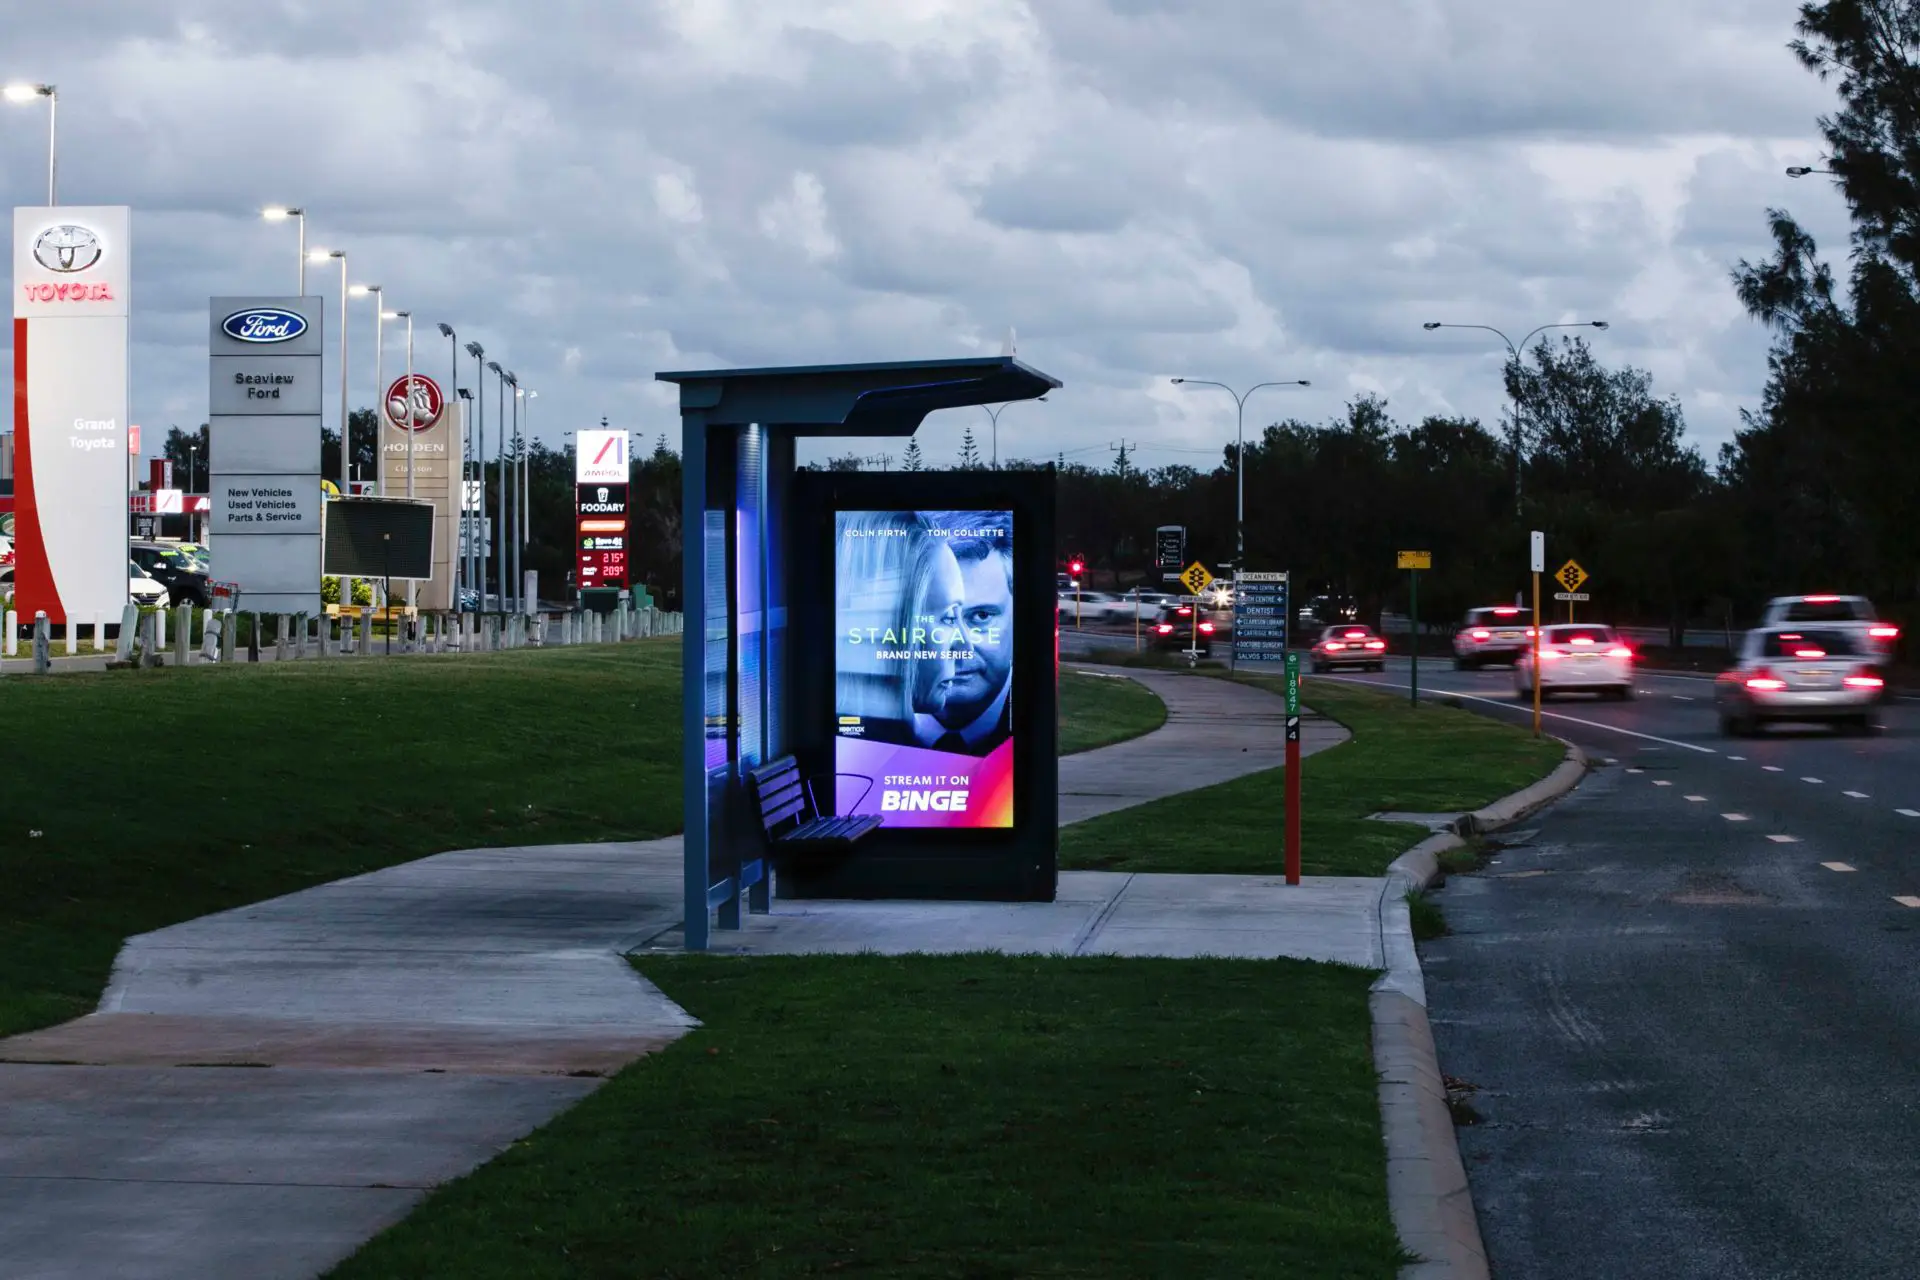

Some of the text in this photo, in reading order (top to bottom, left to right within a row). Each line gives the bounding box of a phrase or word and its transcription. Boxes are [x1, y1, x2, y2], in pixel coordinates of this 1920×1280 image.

[24, 283, 113, 302] TOYOTA
[240, 314, 291, 337] Ford
[235, 372, 294, 385] Seaview
[247, 387, 281, 399] Ford
[74, 418, 116, 431] Grand
[68, 436, 116, 452] Toyota
[584, 469, 623, 477] AMPOL
[228, 488, 293, 497] New Vehicles
[228, 501, 297, 509] Used Vehicles
[581, 503, 625, 512] FOODARY
[228, 512, 302, 522] Parts & Service
[845, 529, 907, 537] COLIN FIRTH
[927, 529, 1004, 537] TONI COLLETTE
[1246, 607, 1275, 615] DENTIST
[915, 615, 935, 623] THE
[849, 627, 1001, 644] STAIRCASE
[876, 651, 974, 660] BRAND NEW SERIES
[1237, 652, 1260, 660] SALVOS
[1289, 671, 1297, 712] 18047
[1288, 731, 1296, 740] 4
[884, 775, 969, 785] STREAM IT ON
